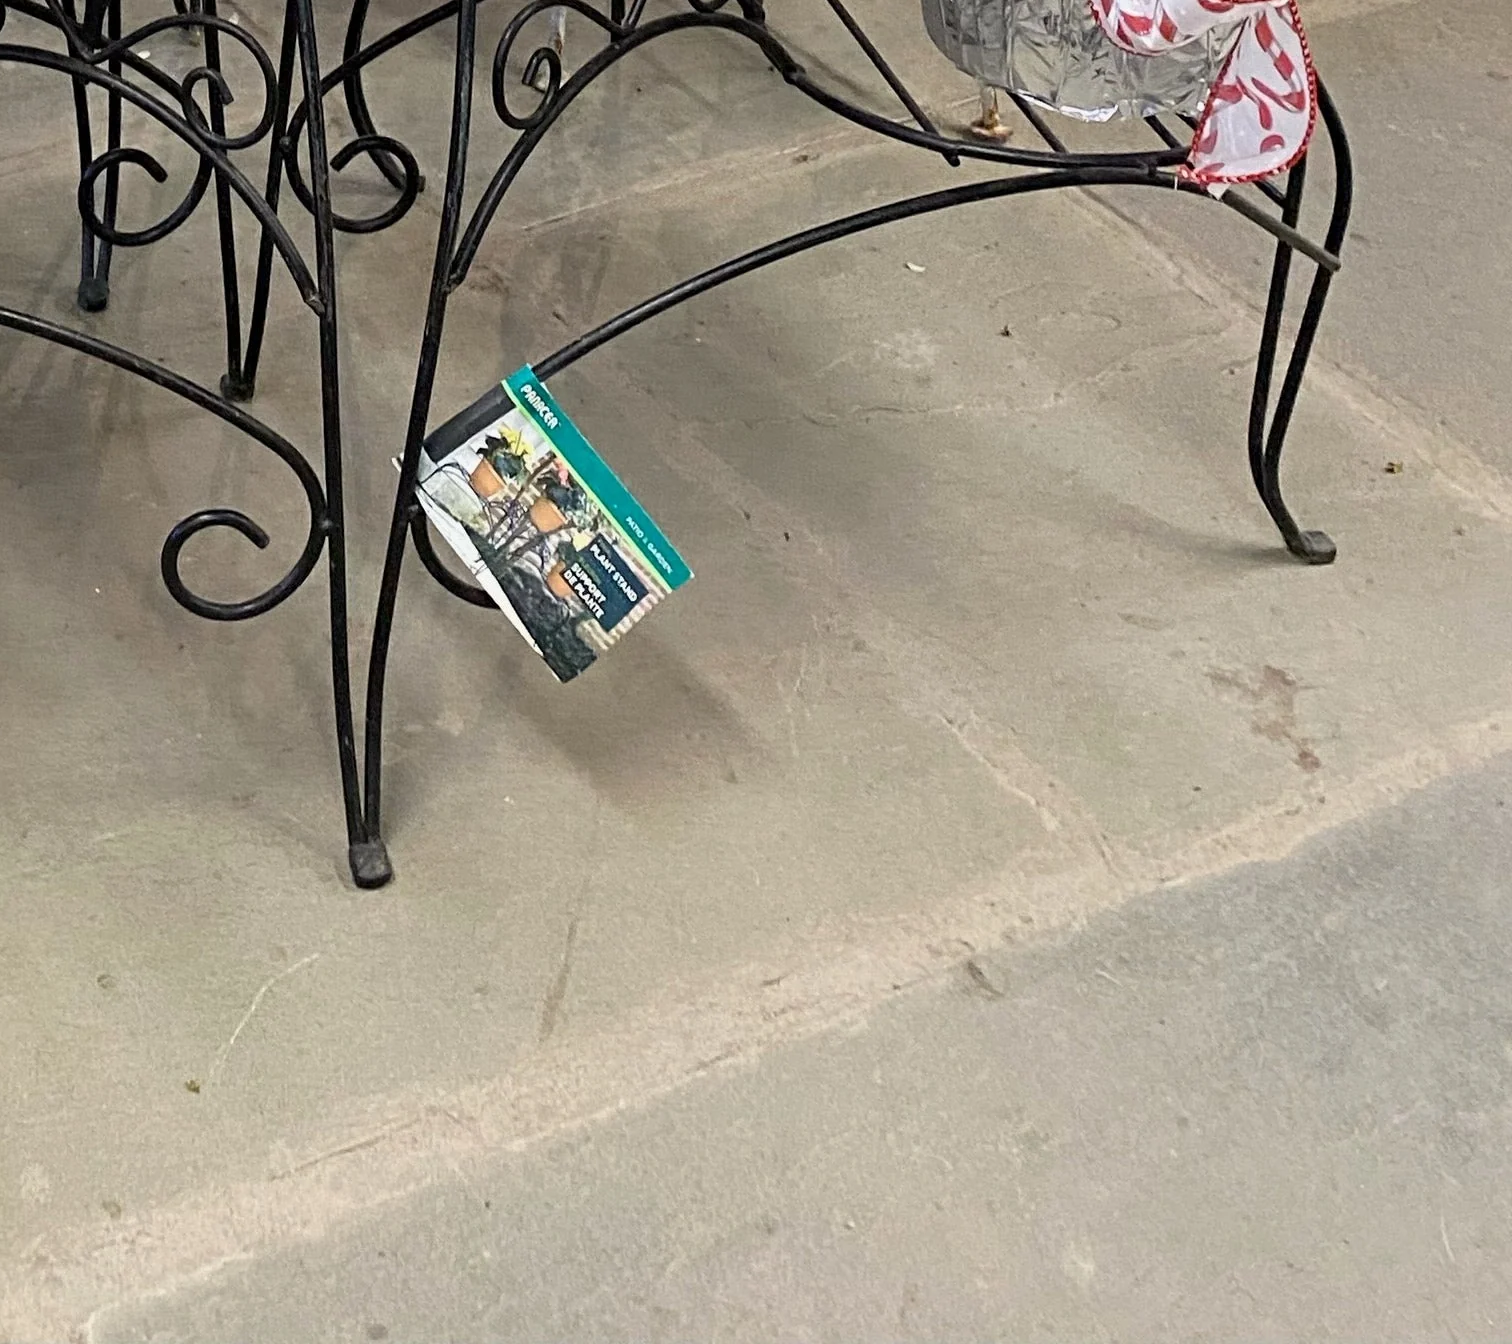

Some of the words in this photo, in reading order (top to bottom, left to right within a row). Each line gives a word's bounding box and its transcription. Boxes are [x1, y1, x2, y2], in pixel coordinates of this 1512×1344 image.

[519, 382, 560, 431] PANACEA
[563, 568, 579, 587] DE
[574, 581, 606, 620] PLANTE
[570, 561, 607, 604] SUPPORT
[589, 542, 616, 574] PLANT
[612, 571, 639, 603] STAND
